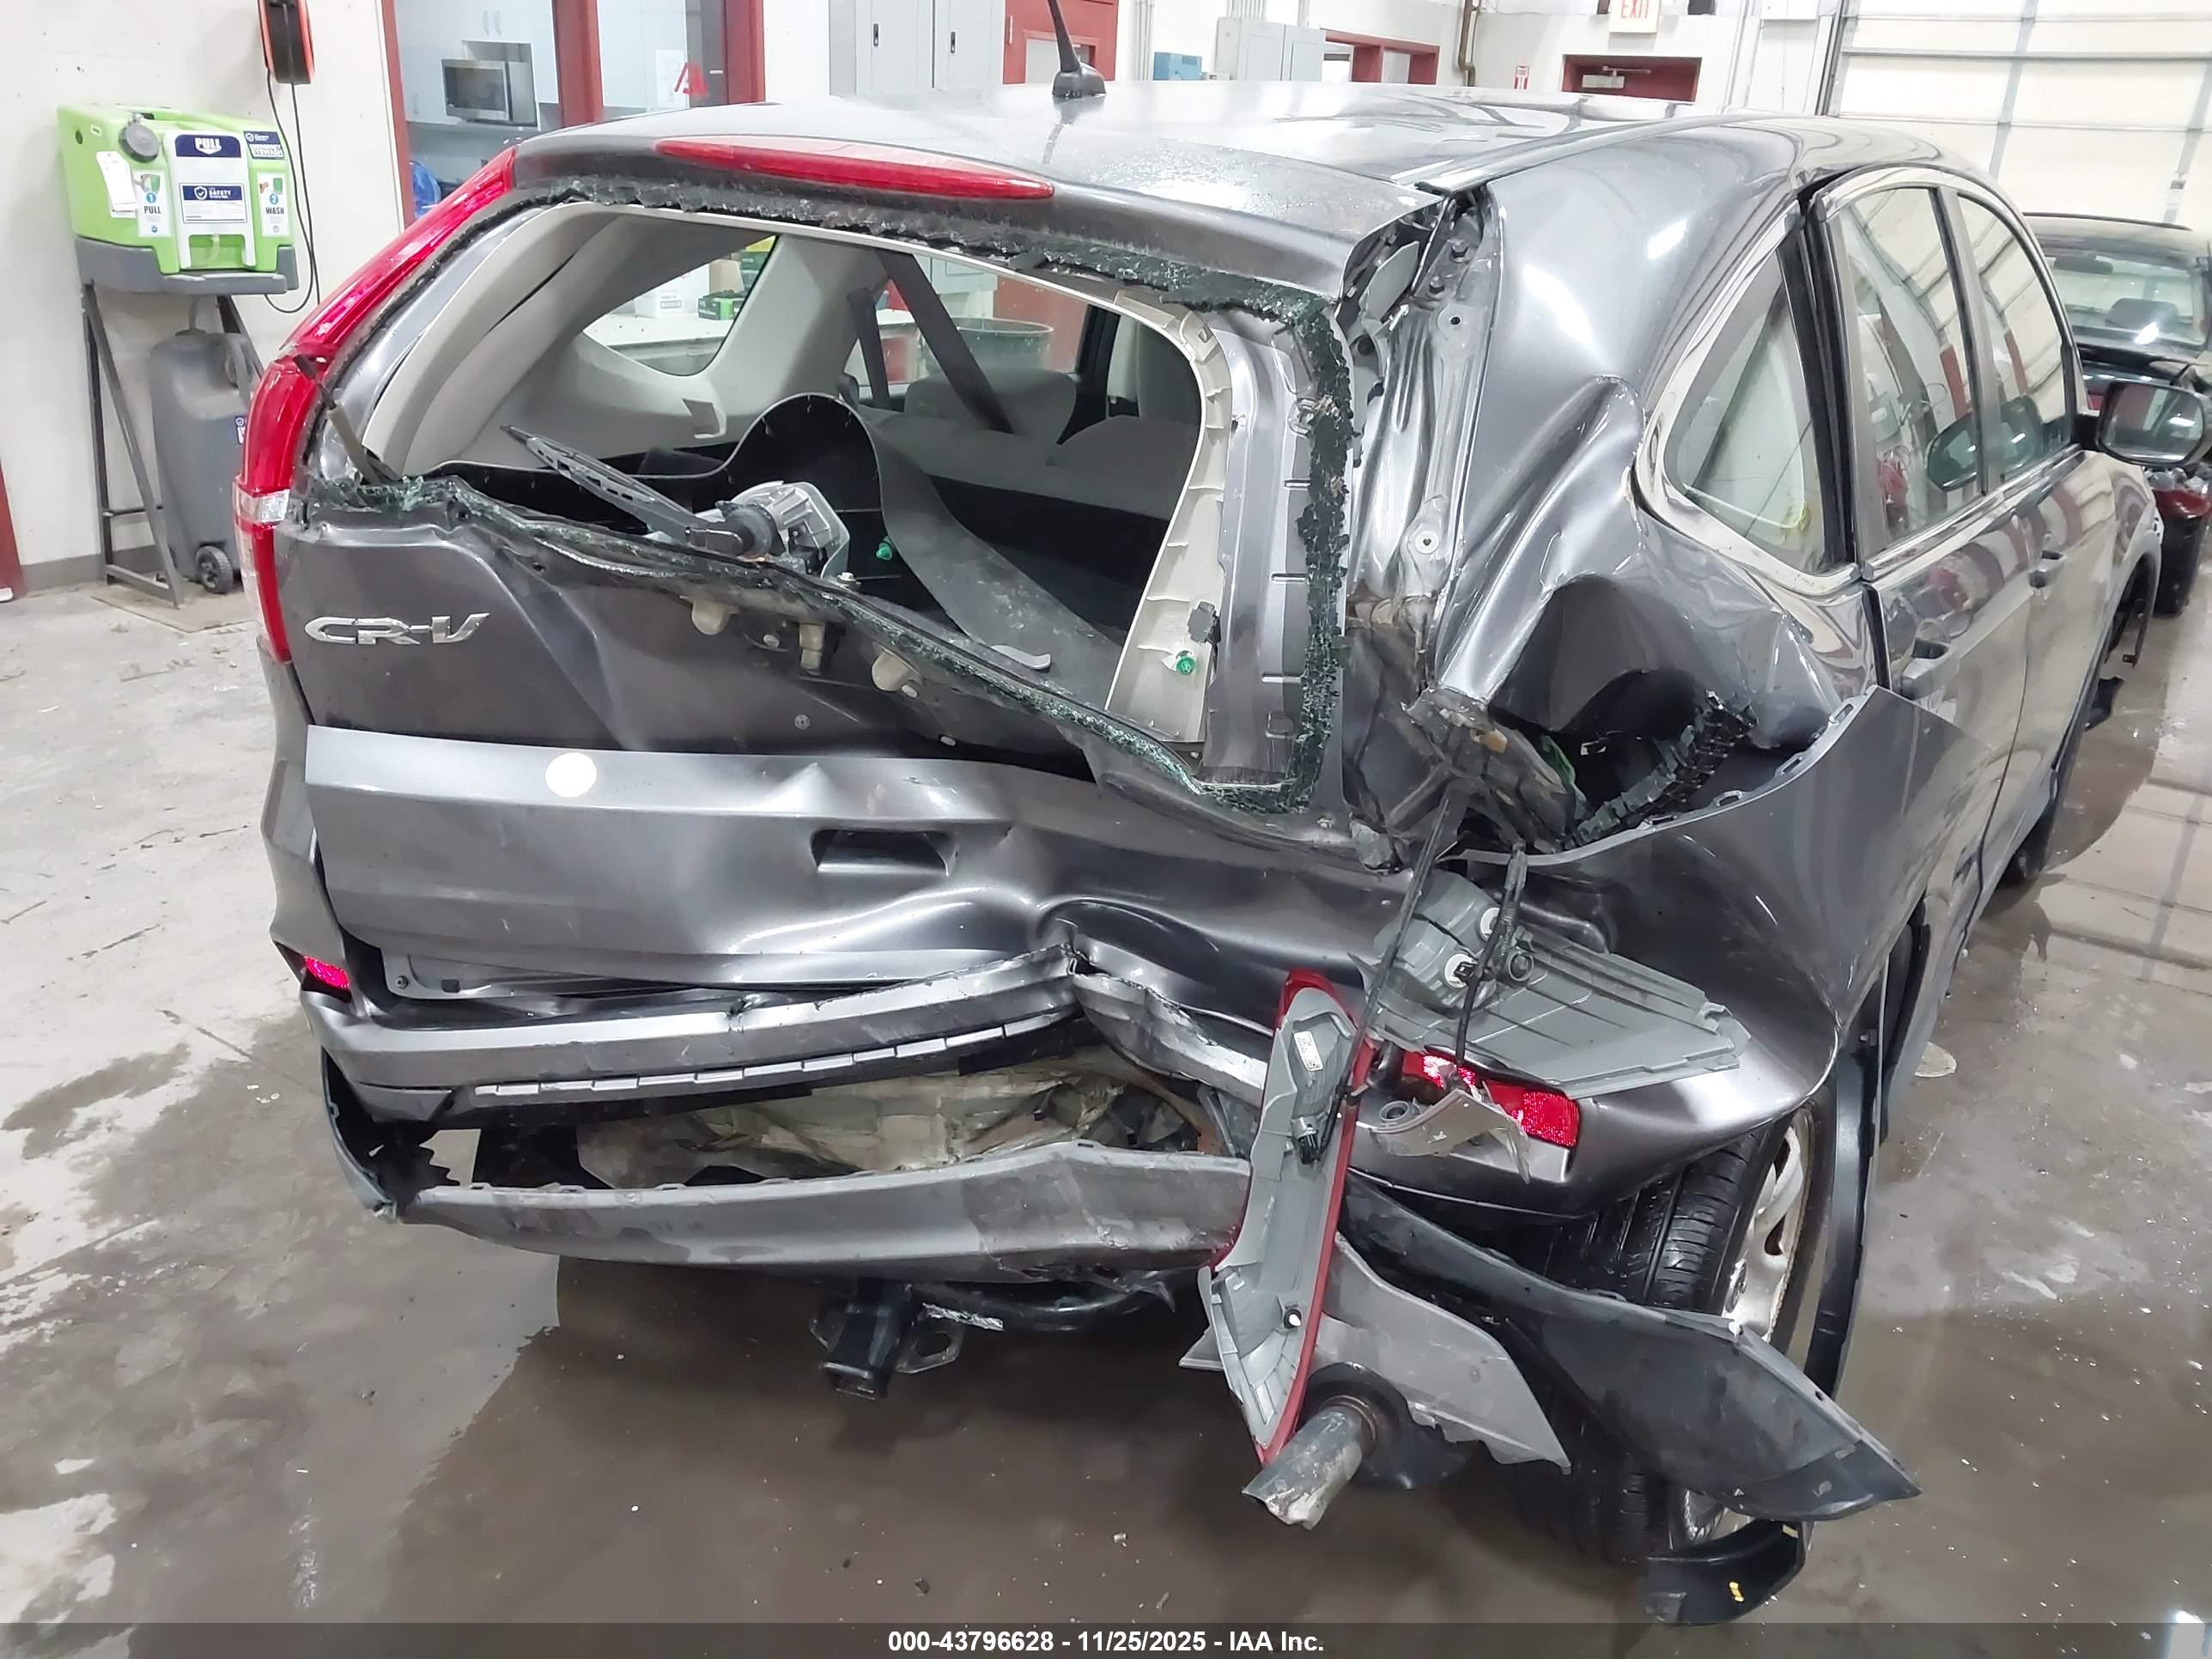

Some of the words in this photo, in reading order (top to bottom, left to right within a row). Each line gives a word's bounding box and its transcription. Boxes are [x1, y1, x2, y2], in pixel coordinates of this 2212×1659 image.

[1621, 0, 1649, 19] EXIT
[194, 137, 221, 149] PULL
[143, 205, 161, 214] PULL
[304, 612, 490, 645] CR-V
